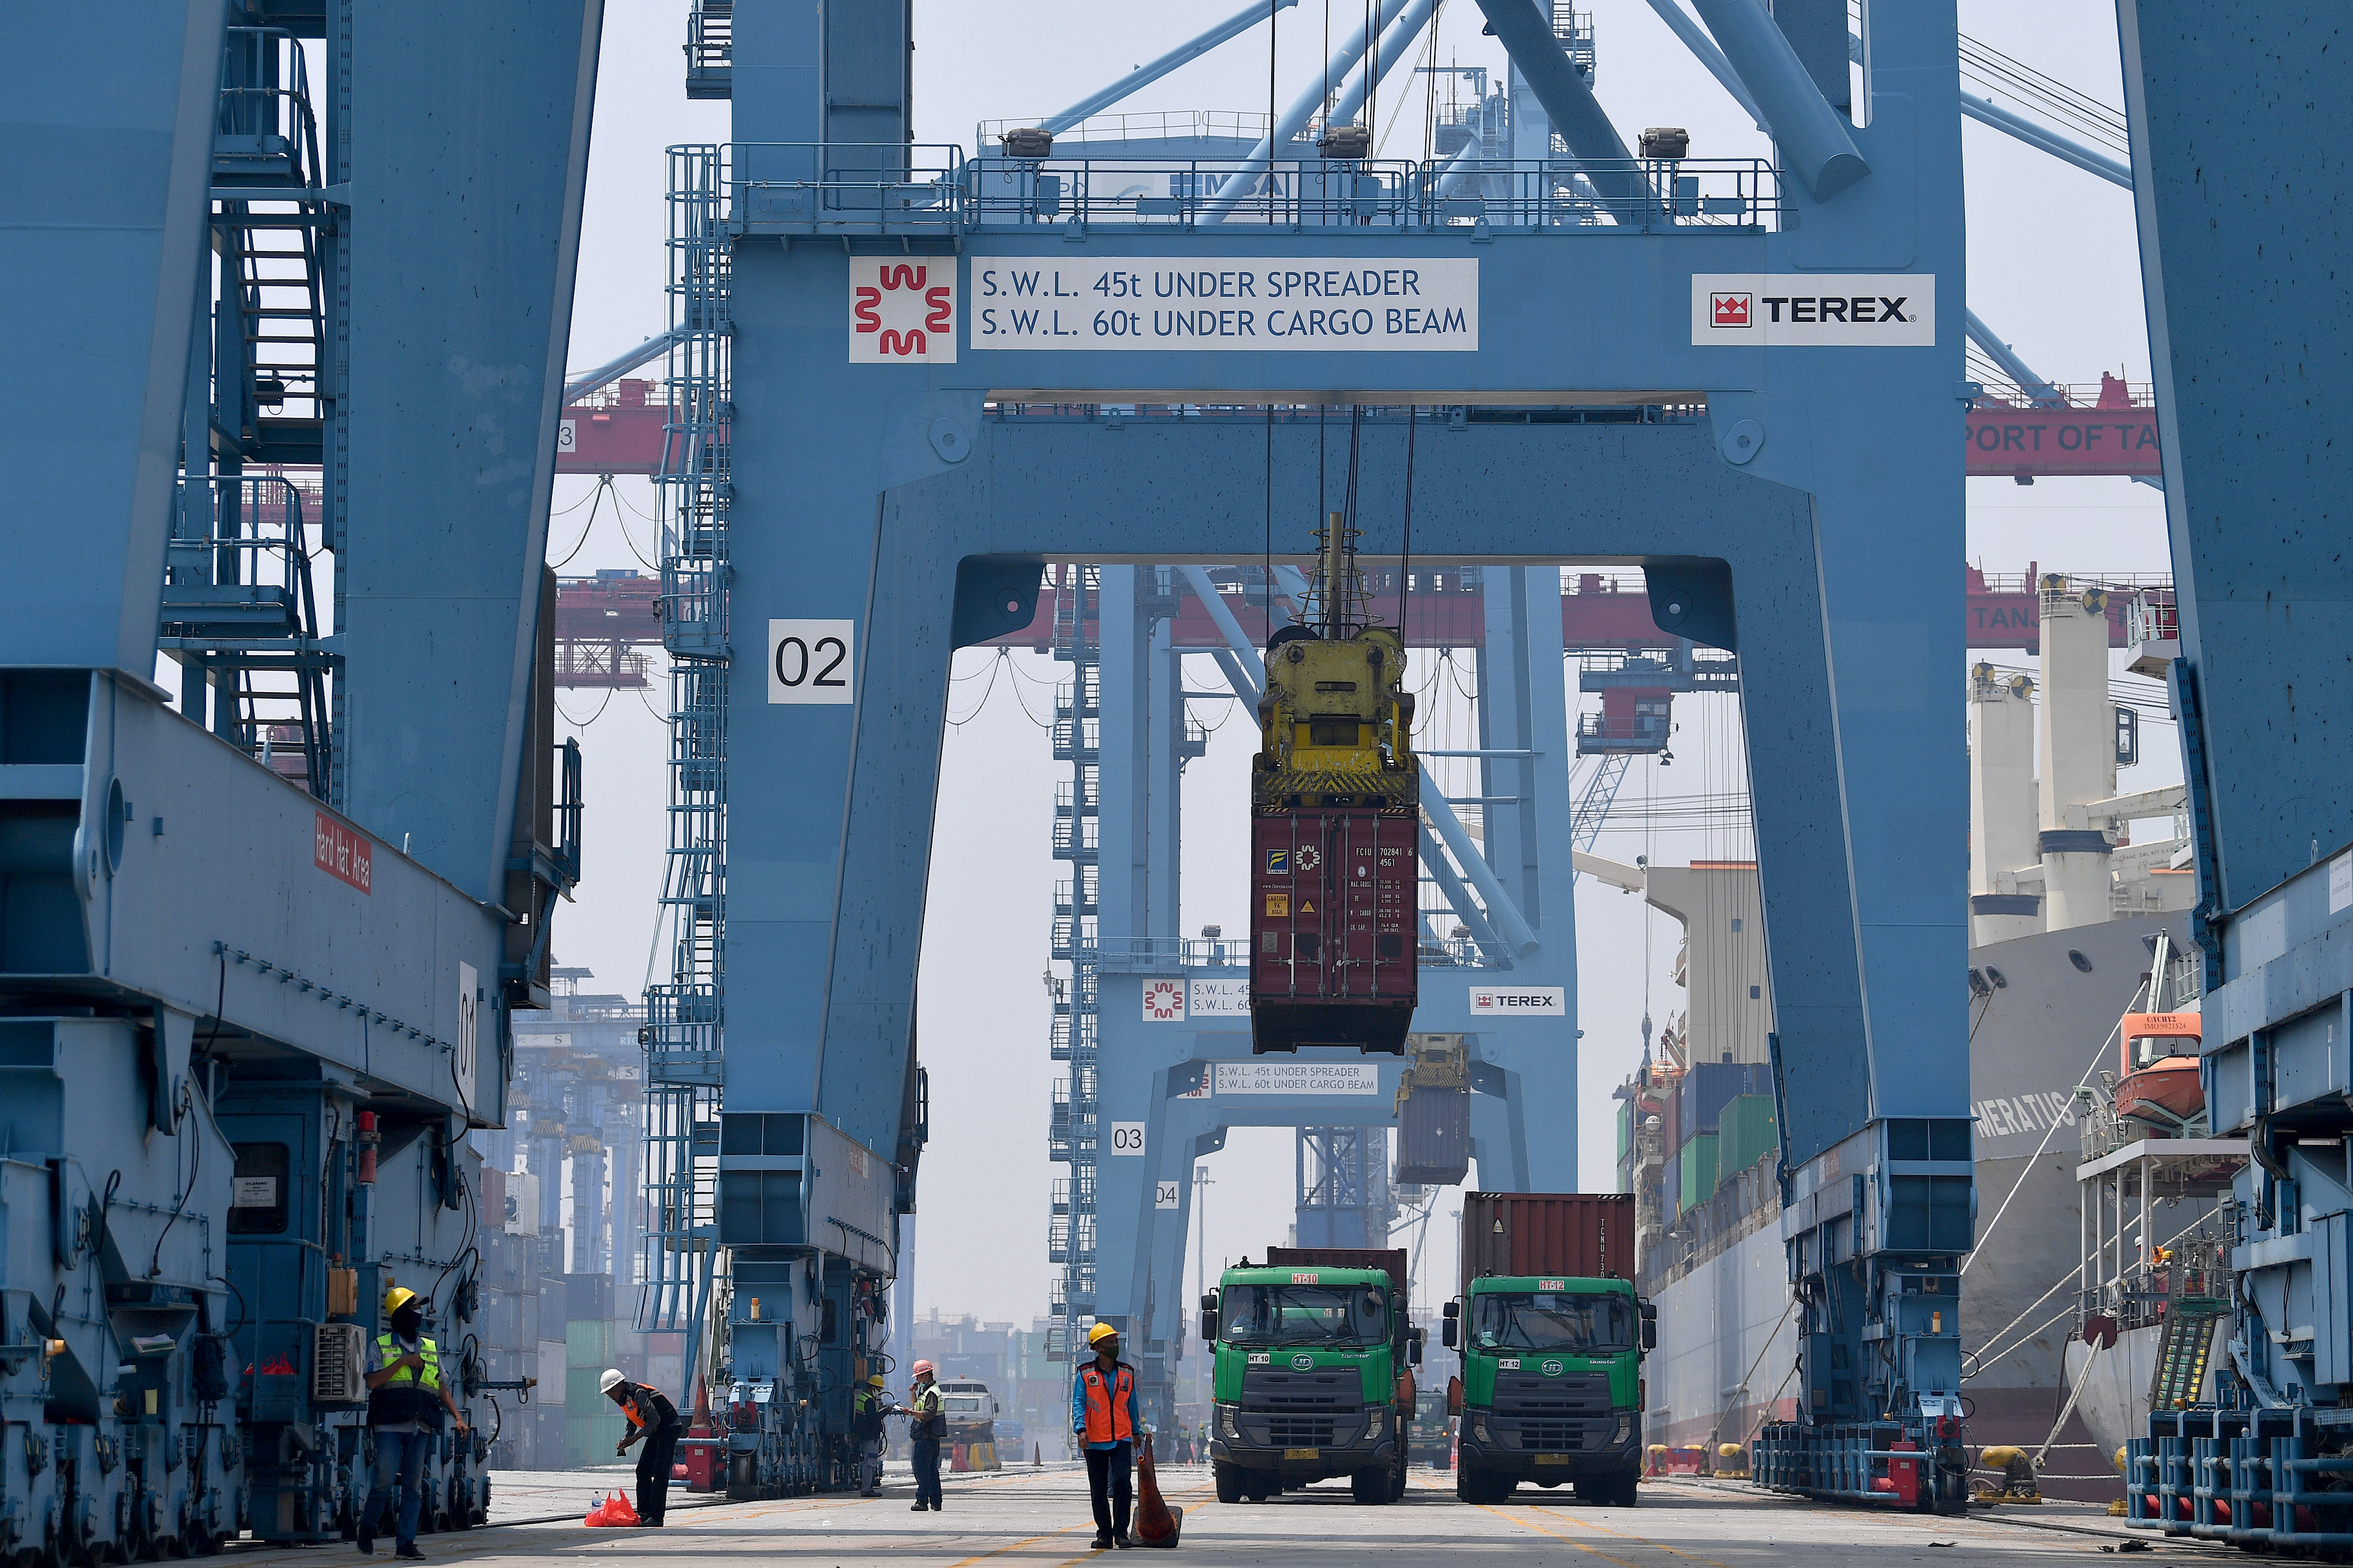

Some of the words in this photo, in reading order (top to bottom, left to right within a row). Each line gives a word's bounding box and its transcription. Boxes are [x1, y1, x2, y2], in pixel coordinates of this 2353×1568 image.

[982, 271, 1079, 297] S.W.L.
[1092, 271, 1142, 298] 45t
[1154, 271, 1257, 298] UNDER
[1267, 269, 1421, 298] SPREADER
[982, 309, 1078, 336] S.W.L.
[1093, 309, 1142, 336] 60t
[1154, 310, 1257, 336] UNDER
[1267, 309, 1374, 336] CARGO
[1386, 306, 1467, 334] BEAM
[2058, 425, 2104, 451] OF
[775, 636, 846, 687] 02
[316, 816, 334, 866] Hard
[336, 829, 349, 876] Hat
[352, 839, 369, 888] Area
[1355, 848, 1372, 856] FCIU
[1379, 848, 1402, 856] 702841
[1379, 858, 1395, 867] 45G1
[1194, 984, 1232, 995] S.W.L.
[1194, 999, 1232, 1010] S.W.L.
[461, 992, 475, 1078] 01
[1218, 1067, 1251, 1076] S.W.L.
[1254, 1067, 1271, 1076] 45t
[1274, 1067, 1307, 1076] UNDER
[1310, 1067, 1359, 1077] SPREADER
[1218, 1079, 1251, 1089] S.W.L.
[1254, 1080, 1271, 1089] 60t
[1274, 1080, 1307, 1089] UNDER
[1309, 1080, 1345, 1089] CARGO
[1348, 1080, 1375, 1089] BEAM
[1970, 1090, 2076, 1139] MERATUS
[1114, 1129, 1142, 1149] 03
[1155, 1186, 1177, 1203] 04
[1292, 1274, 1318, 1284] HT-10
[1539, 1280, 1564, 1290] HT-12
